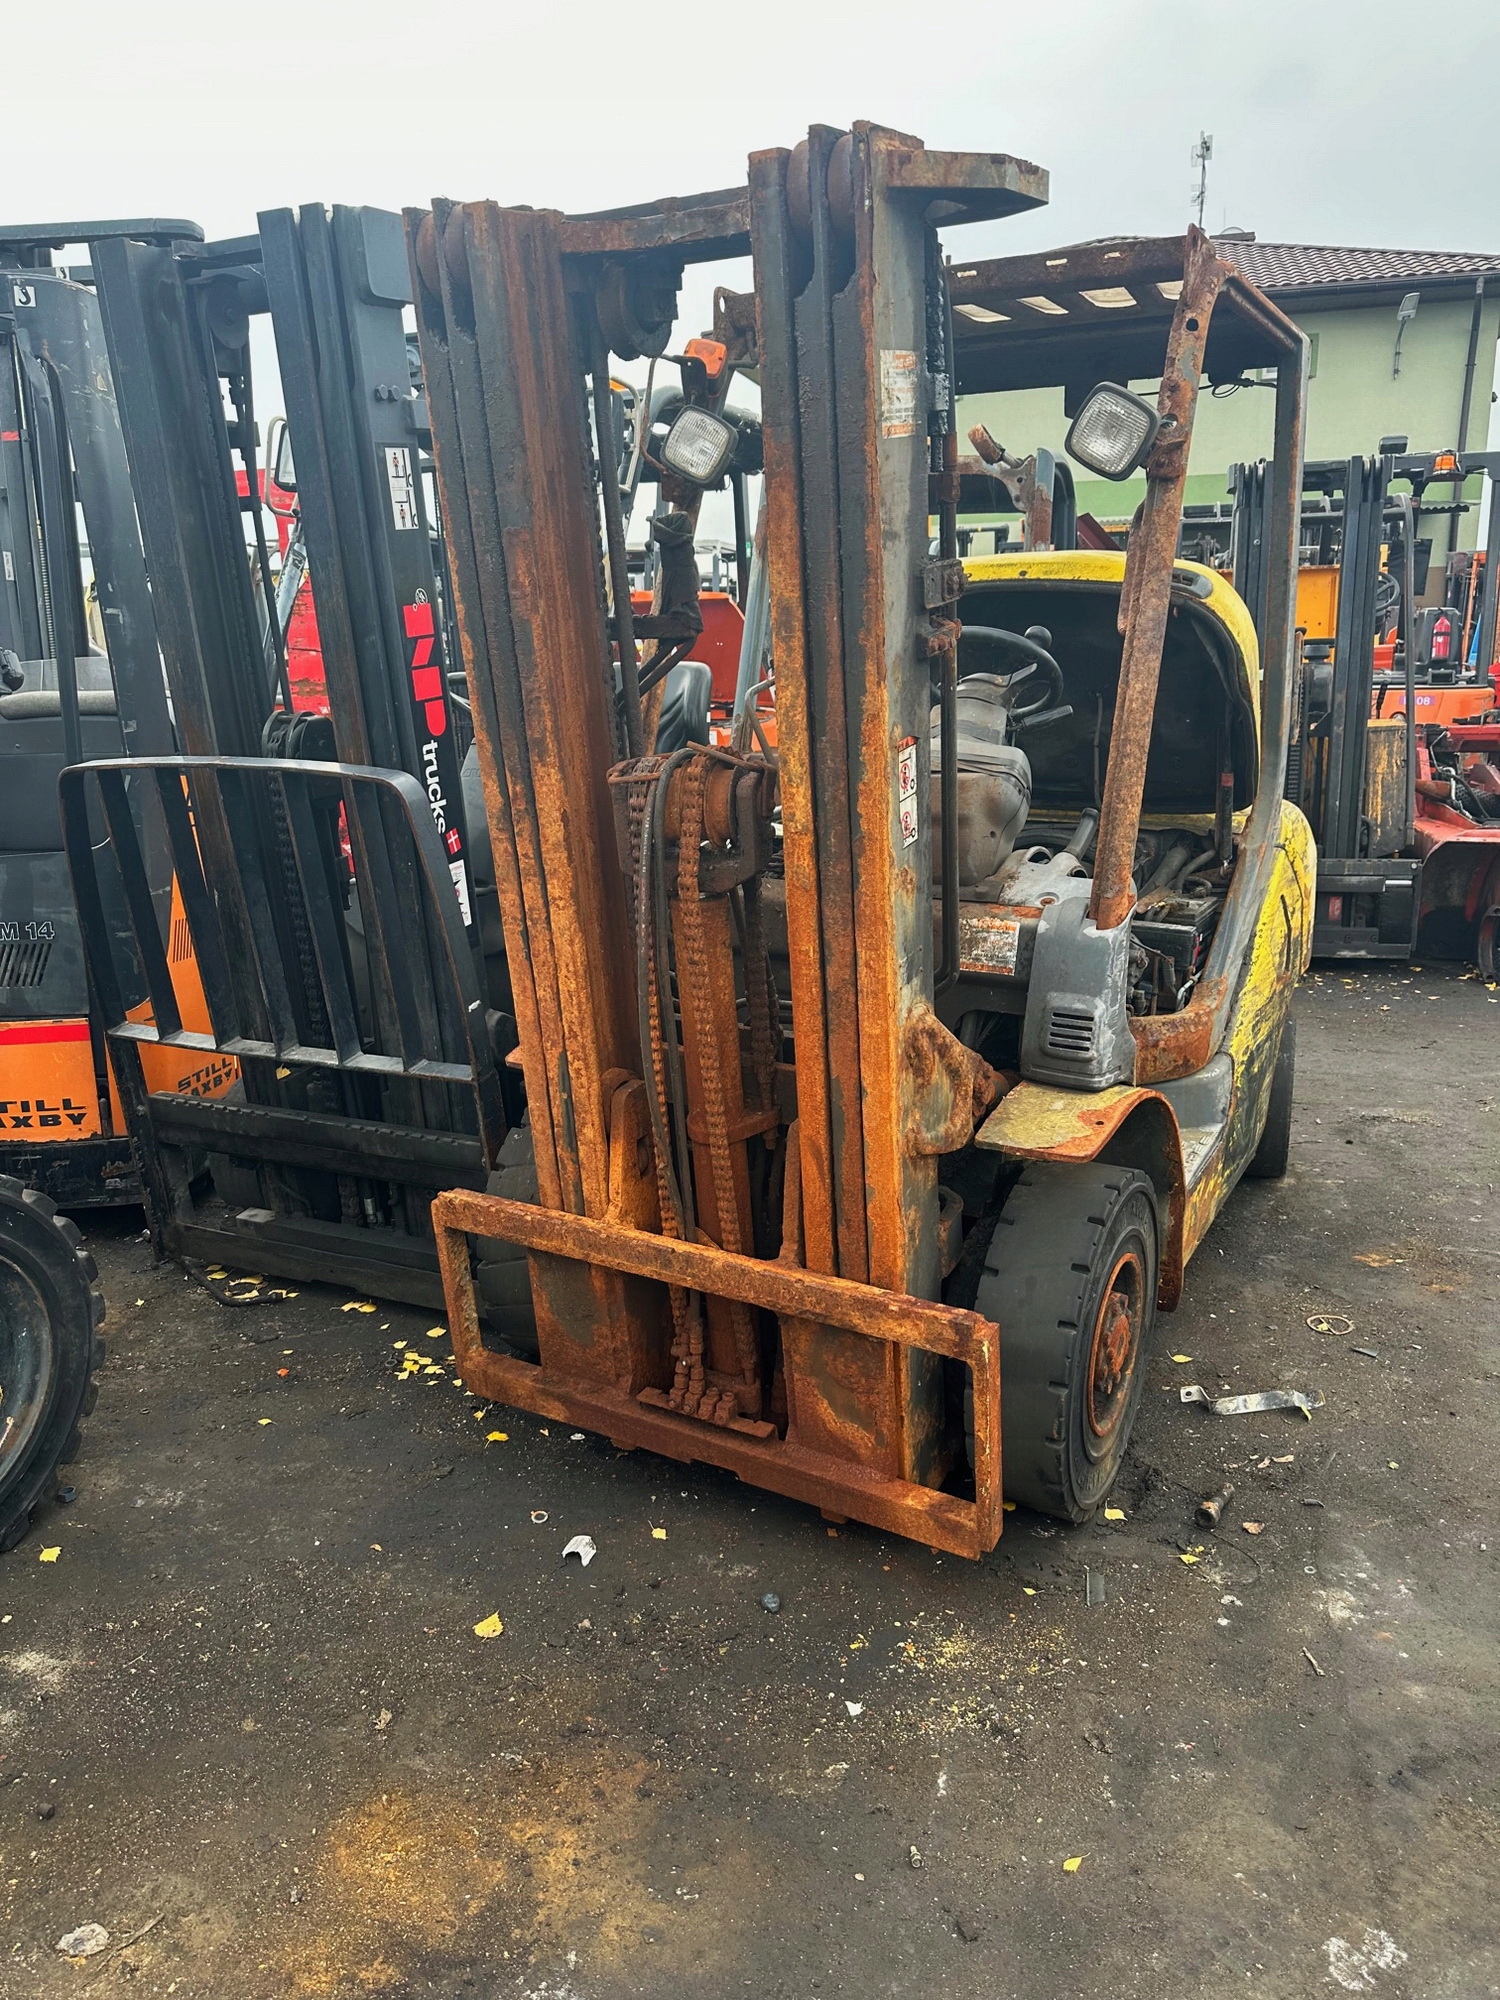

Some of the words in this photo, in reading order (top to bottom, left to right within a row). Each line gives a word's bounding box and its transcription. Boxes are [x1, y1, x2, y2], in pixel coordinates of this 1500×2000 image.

[422, 739, 447, 834] trucks
[25, 921, 56, 941] 14
[178, 1057, 232, 1093] STILL
[185, 1067, 233, 1097] AXBY
